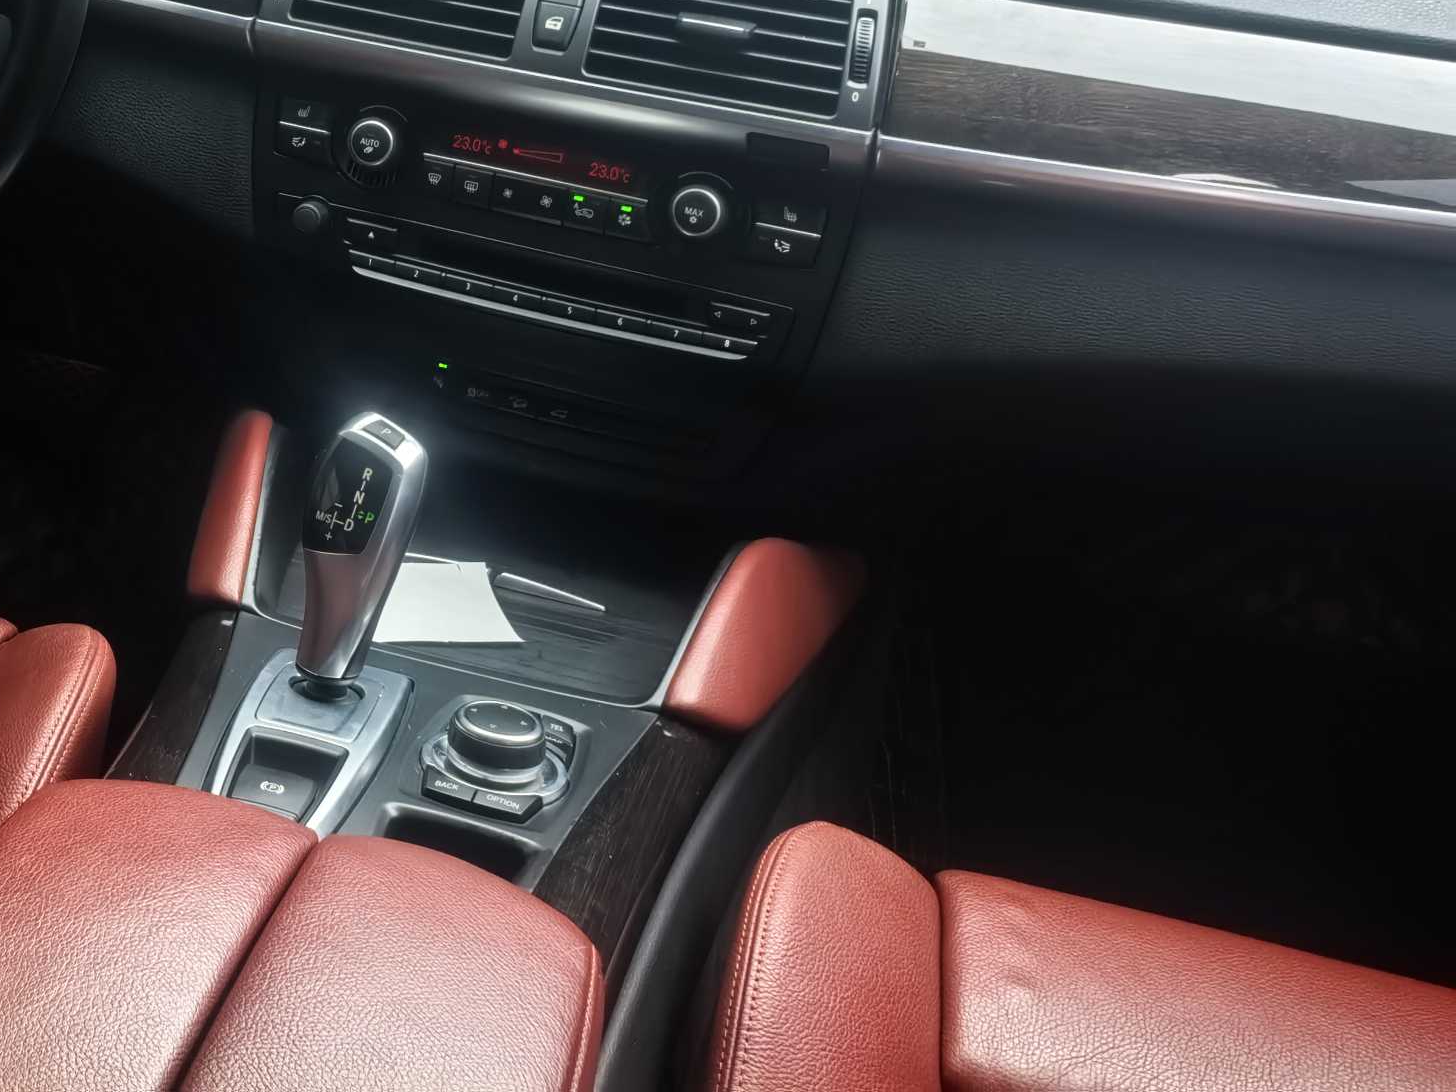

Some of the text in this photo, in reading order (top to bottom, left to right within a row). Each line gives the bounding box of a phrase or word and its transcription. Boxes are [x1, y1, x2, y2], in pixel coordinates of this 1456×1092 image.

[359, 137, 380, 148] AUTO
[683, 206, 705, 218] MAX
[362, 467, 374, 481] R
[353, 490, 366, 505] N
[315, 510, 332, 525] M/S
[343, 518, 354, 532] D
[434, 779, 459, 791] BACK
[486, 794, 520, 810] OPTION
